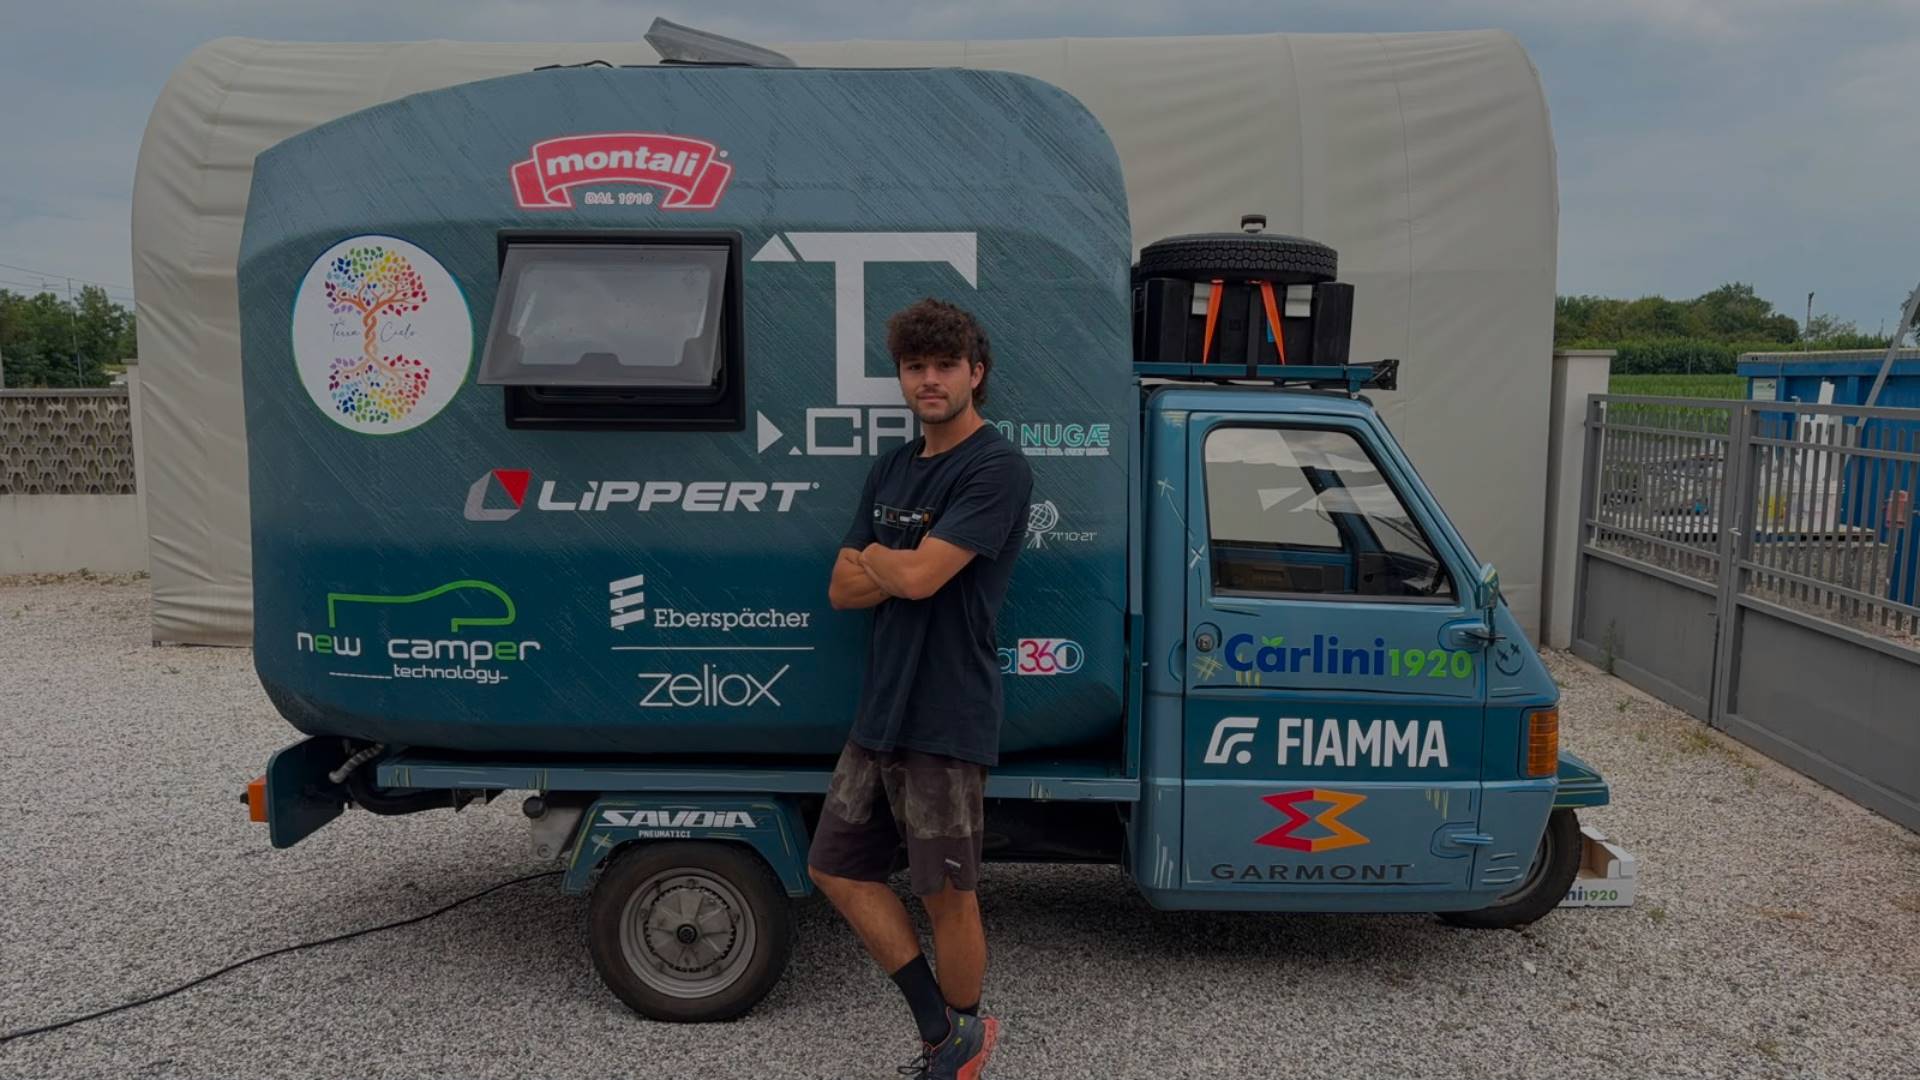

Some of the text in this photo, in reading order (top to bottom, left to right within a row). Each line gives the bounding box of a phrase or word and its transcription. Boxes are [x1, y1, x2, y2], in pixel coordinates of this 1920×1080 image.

[546, 146, 701, 177] montali
[584, 191, 615, 206] DAL
[653, 608, 811, 632] Eberspächer
[297, 632, 541, 670] new camper
[393, 663, 500, 685] technology
[638, 664, 791, 708] zeliox
[1277, 717, 1449, 768] FIAMMA
[638, 829, 692, 839] PNEUMATICI
[1210, 863, 1410, 881] GARMONT
